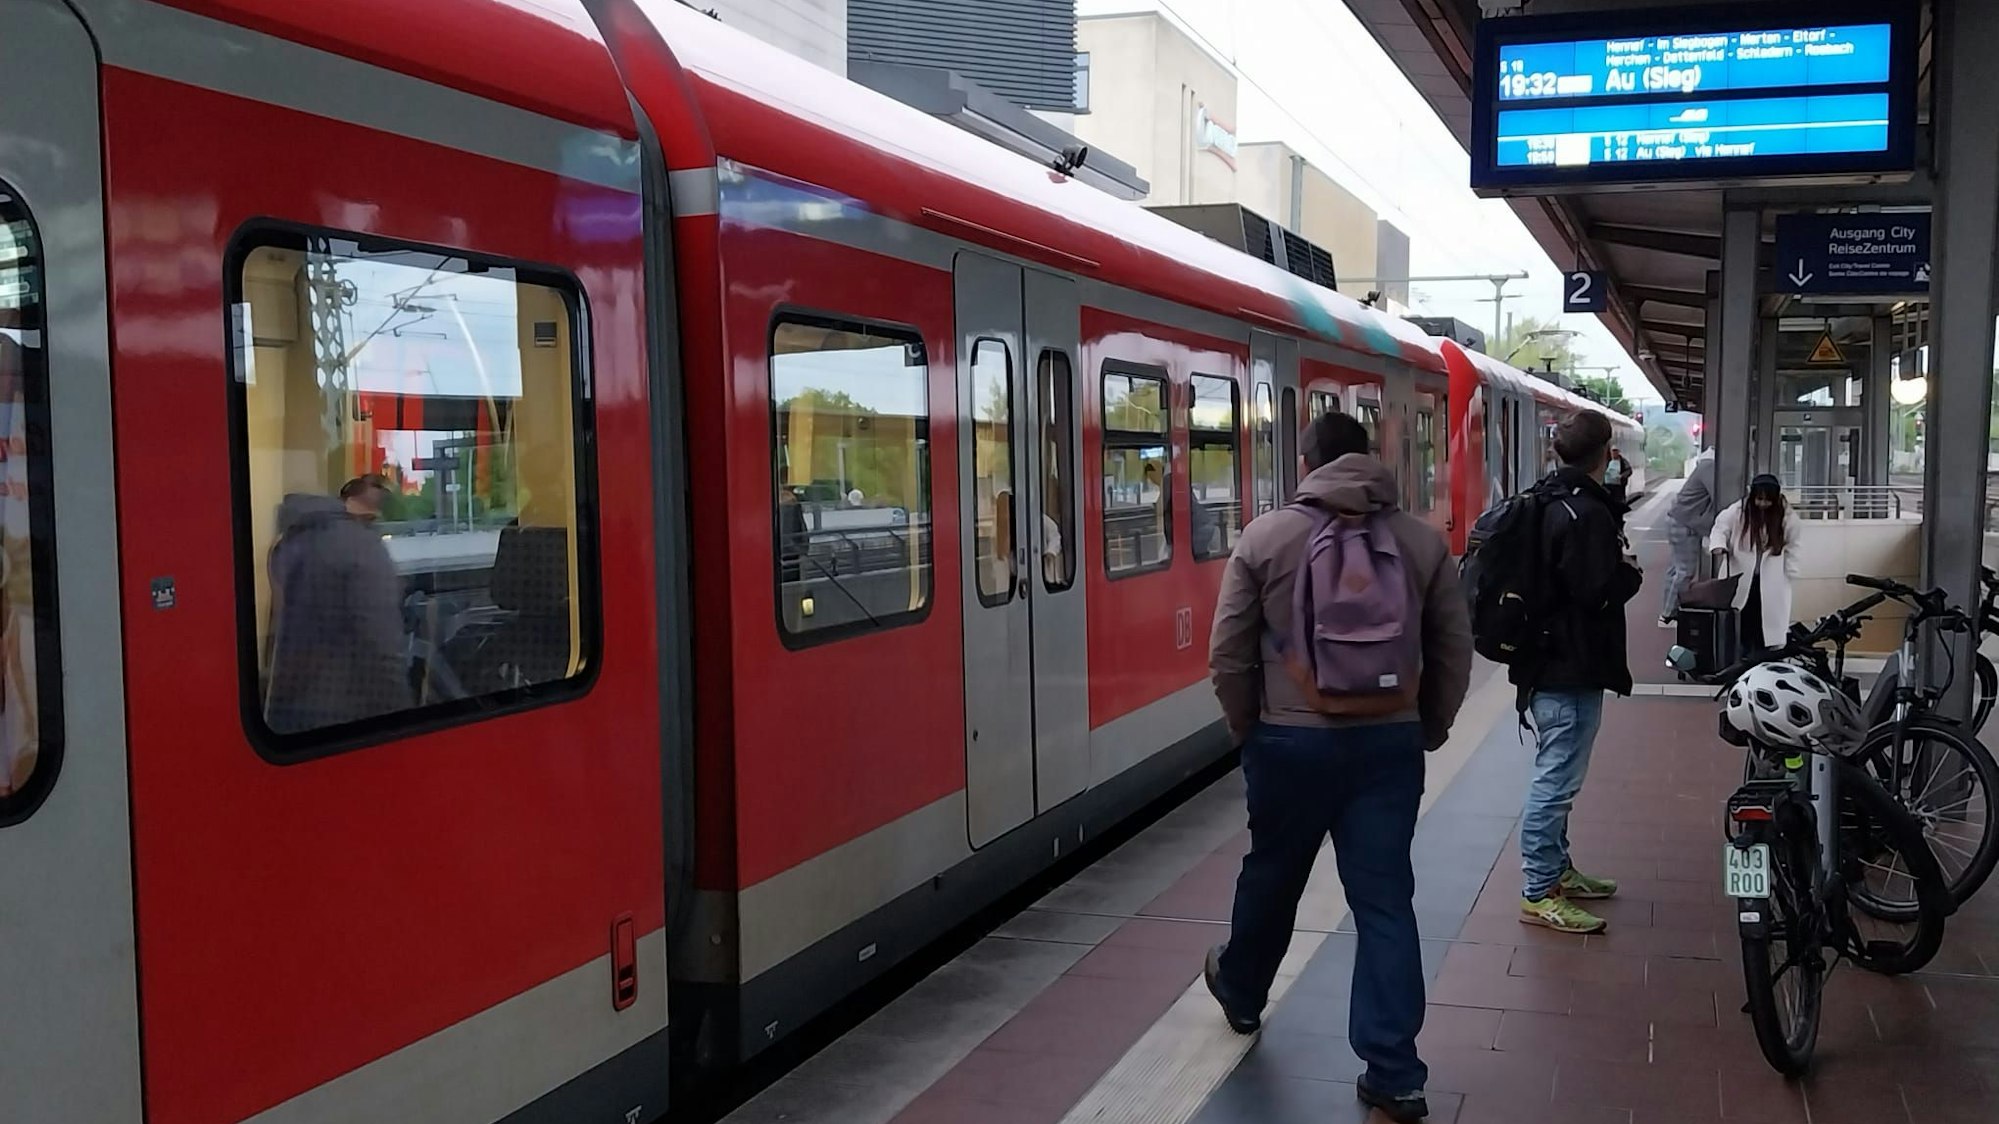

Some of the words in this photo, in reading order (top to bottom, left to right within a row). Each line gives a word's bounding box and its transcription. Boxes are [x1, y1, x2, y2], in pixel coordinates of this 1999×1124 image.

[1500, 71, 1557, 97] 19:32
[1605, 67, 1636, 91] Au
[1642, 64, 1702, 93] (Sieg)
[1829, 227, 1886, 241] Ausgang
[1890, 226, 1916, 240] City
[1828, 242, 1917, 255] ReiseZentrum
[1568, 272, 1592, 304] 2
[1666, 401, 1674, 411] 2
[1176, 607, 1193, 650] DB
[1729, 848, 1763, 869] 403
